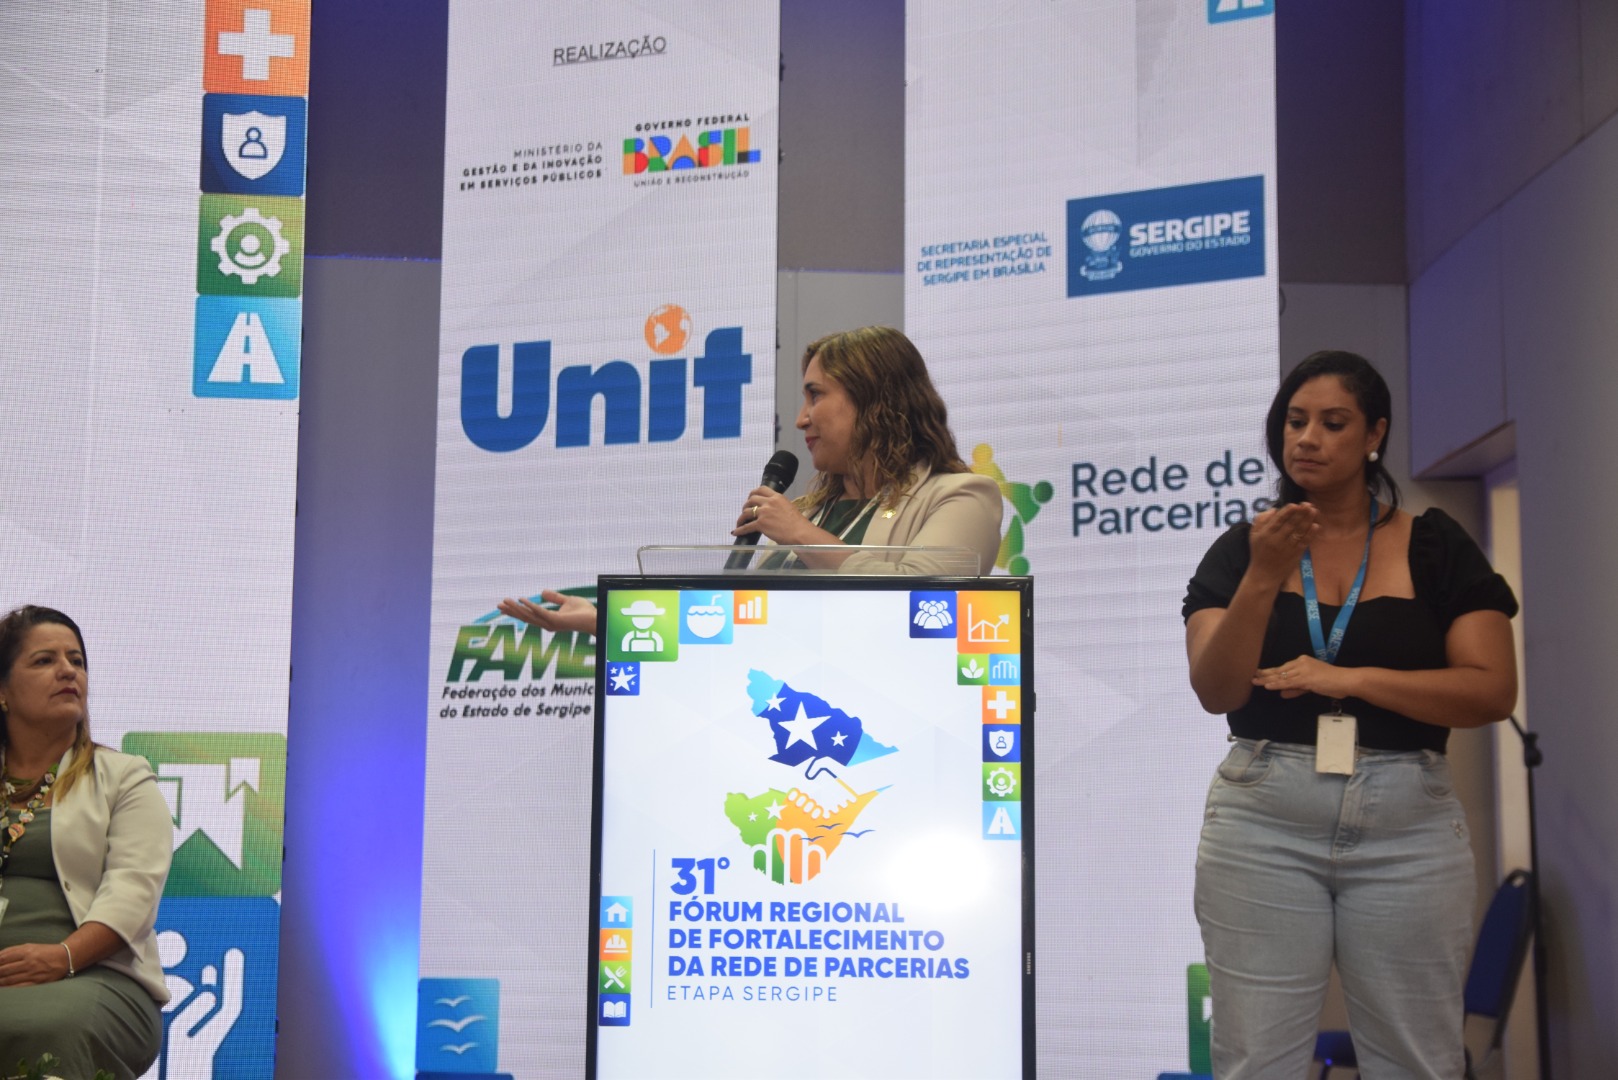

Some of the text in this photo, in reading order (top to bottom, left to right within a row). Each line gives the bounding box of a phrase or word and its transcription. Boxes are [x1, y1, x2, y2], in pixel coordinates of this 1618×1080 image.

[553, 35, 667, 65] REALIZAÇÃO
[635, 113, 750, 132] GOVERNO FEDERAL
[513, 141, 602, 158] MINISTÉRIO DA
[623, 126, 761, 176] BRASIL
[463, 154, 602, 177] GESTÃO E DA INOVAÇÃO
[460, 169, 602, 191] EM SERVIÇOS PÚBLICOS
[666, 177, 671, 185] E
[1129, 210, 1251, 247] SERGIPE
[921, 231, 1047, 257] SECRETARIA ESPECIAL
[1129, 234, 1251, 258] GOVERNO DO ESTADO
[917, 245, 1051, 272] DE REPRESENTAÇÃO DE
[923, 261, 1046, 286] SERGIPE EM BRASÍLIA
[460, 304, 752, 453] Unit
[1072, 449, 1265, 498] Rede de
[442, 682, 594, 700] Federação dos Munic
[440, 702, 591, 719] do Estado de Sergipe
[669, 895, 905, 923] FÓRUM REGIONAL
[669, 928, 945, 951] DE FORTALECIMENTO
[668, 955, 970, 979] DA REDE DE PARCERIAS
[667, 985, 837, 1002] ETAPA SERGIPE
